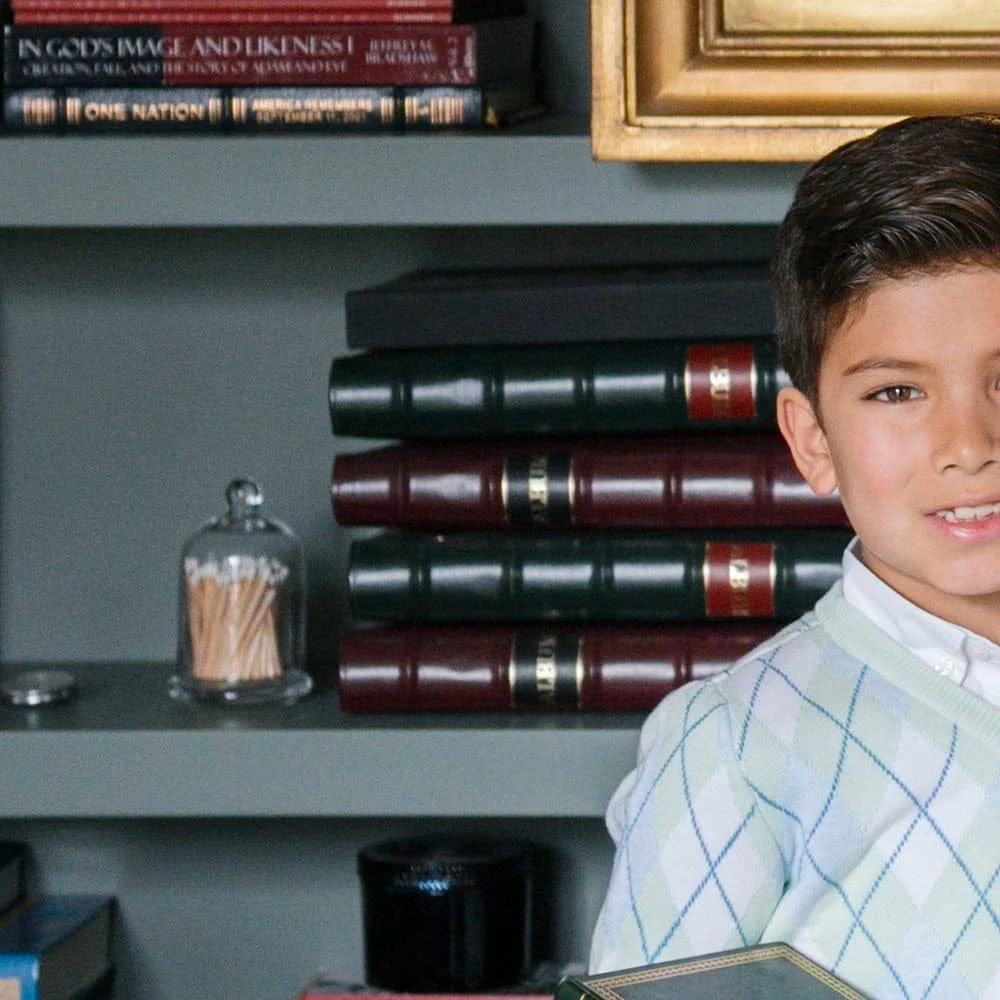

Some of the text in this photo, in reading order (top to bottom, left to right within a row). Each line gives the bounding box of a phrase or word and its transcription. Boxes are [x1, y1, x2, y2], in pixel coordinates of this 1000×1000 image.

[18, 37, 42, 59] IN
[117, 36, 182, 58] IMAGE
[190, 35, 241, 58] AND
[245, 35, 343, 57] LIKENESS
[85, 102, 204, 121] ONE NATION
